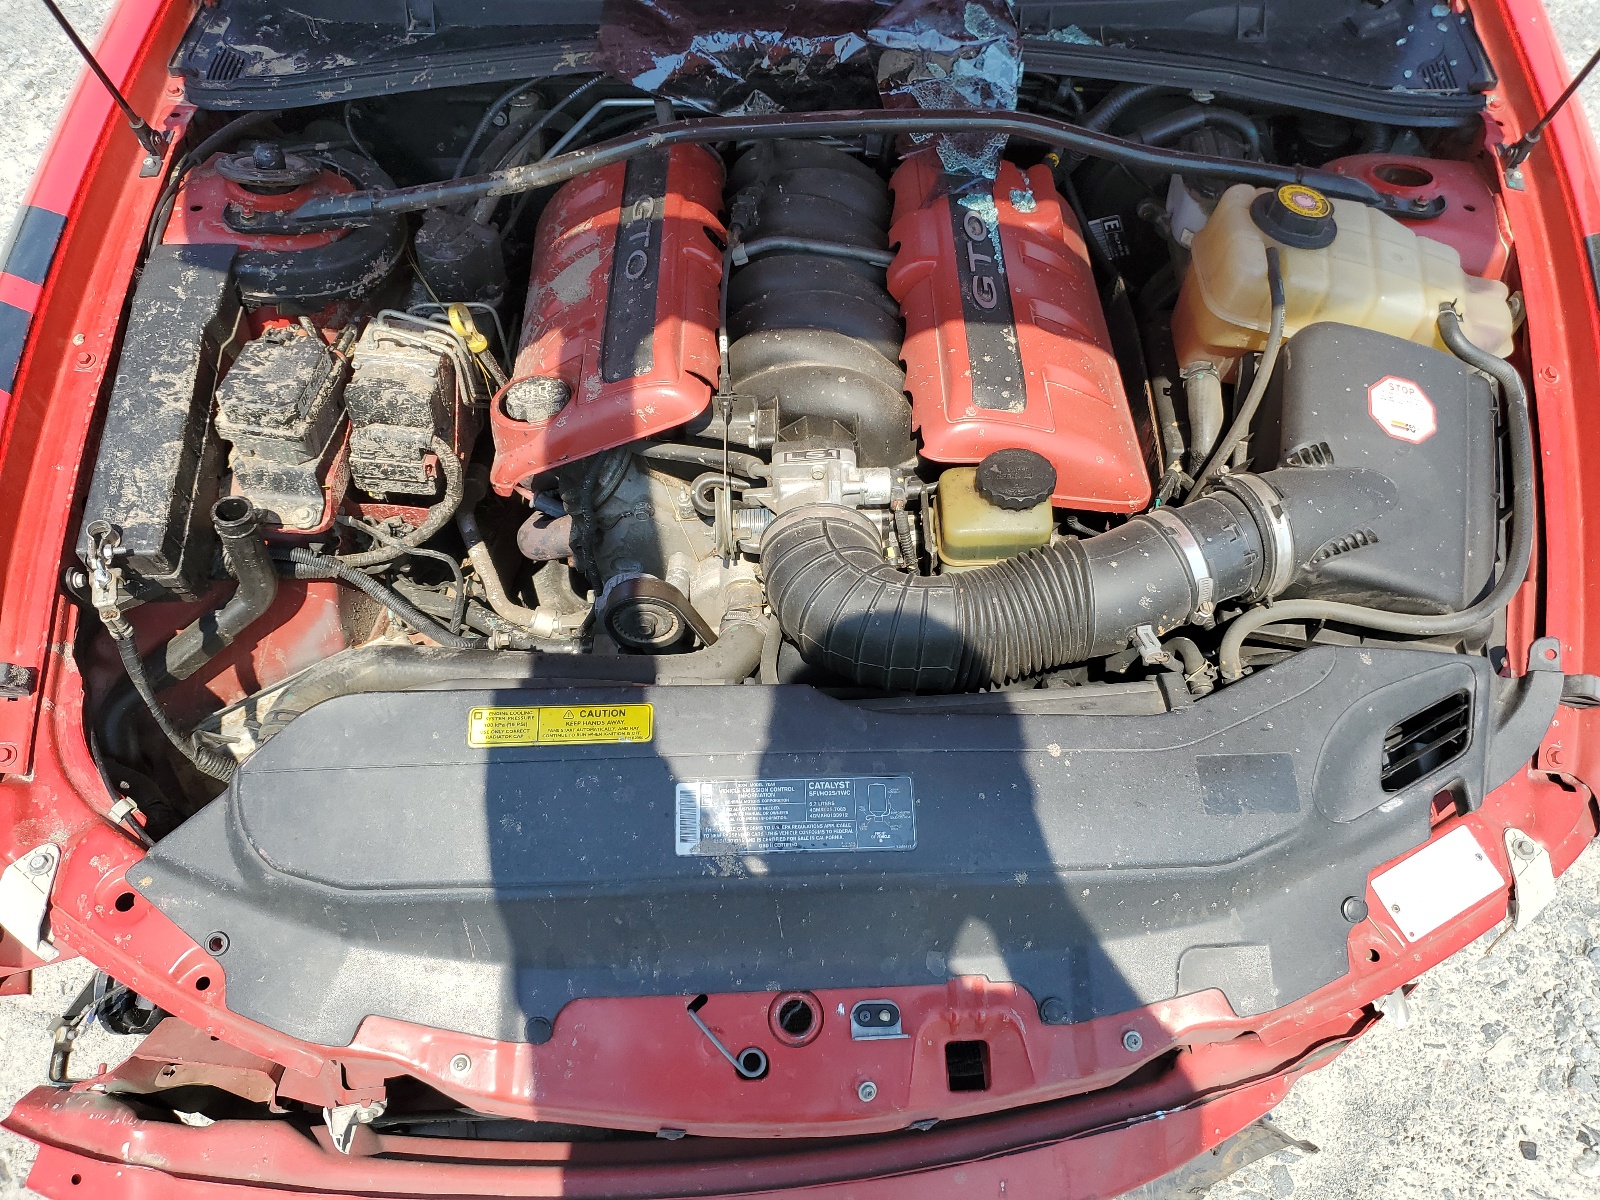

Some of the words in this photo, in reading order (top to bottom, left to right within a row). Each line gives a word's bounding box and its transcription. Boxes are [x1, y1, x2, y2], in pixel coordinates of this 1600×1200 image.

[625, 194, 655, 280] GTO
[963, 210, 998, 309] GTO
[1388, 382, 1415, 395] STOP
[579, 709, 626, 718] CAUTION
[808, 781, 851, 790] CATALYST
